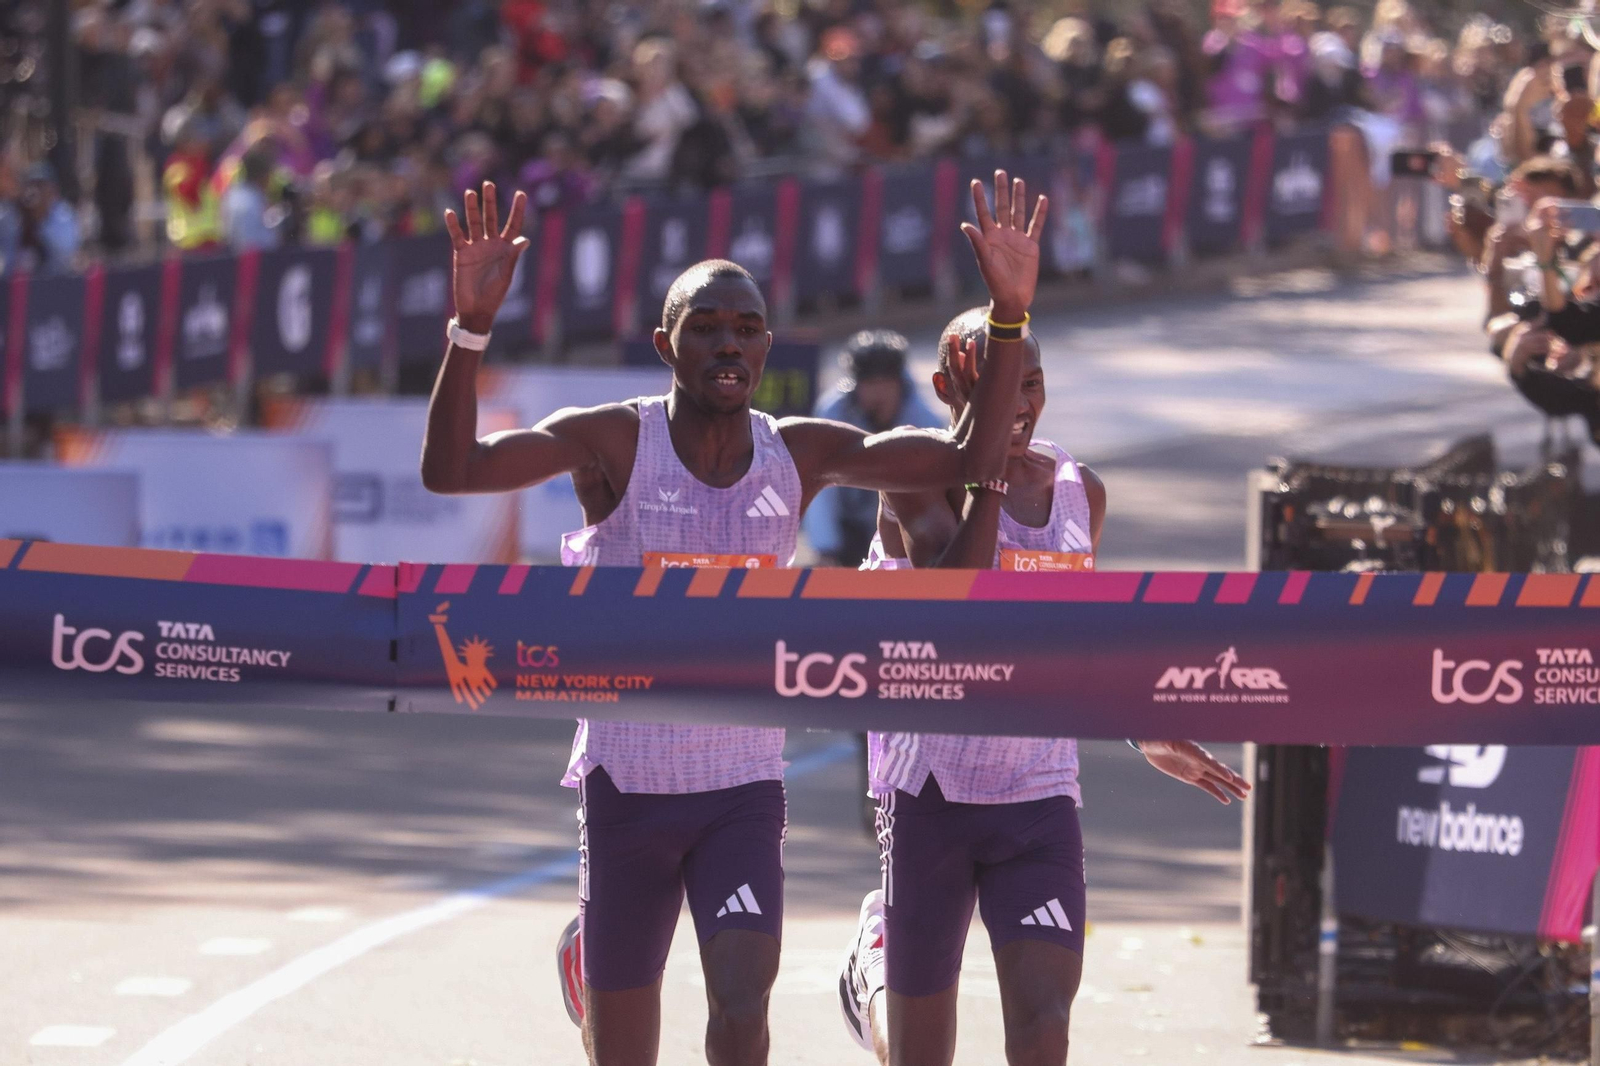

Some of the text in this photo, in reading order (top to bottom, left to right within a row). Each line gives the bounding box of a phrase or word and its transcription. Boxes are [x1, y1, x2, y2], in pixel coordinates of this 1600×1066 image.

[669, 504, 698, 515] Angels
[157, 620, 215, 641] TATA
[51, 613, 145, 676] tcs
[516, 639, 560, 668] tcs
[878, 641, 938, 660] TATA
[155, 641, 292, 668] CONSULTANCY
[1536, 648, 1594, 665] TATA
[154, 662, 241, 683] SERVICES
[774, 639, 868, 699] tcs
[878, 662, 1015, 682] CONSULTANCY
[1431, 648, 1524, 705] tcs
[516, 674, 654, 690] NEW YORK CITY
[877, 682, 965, 701] SERVICES
[515, 690, 620, 703] MARATHON
[1152, 693, 1290, 704] NEW YORK ROAD RUNNERS
[1533, 686, 1600, 705] SERVIC
